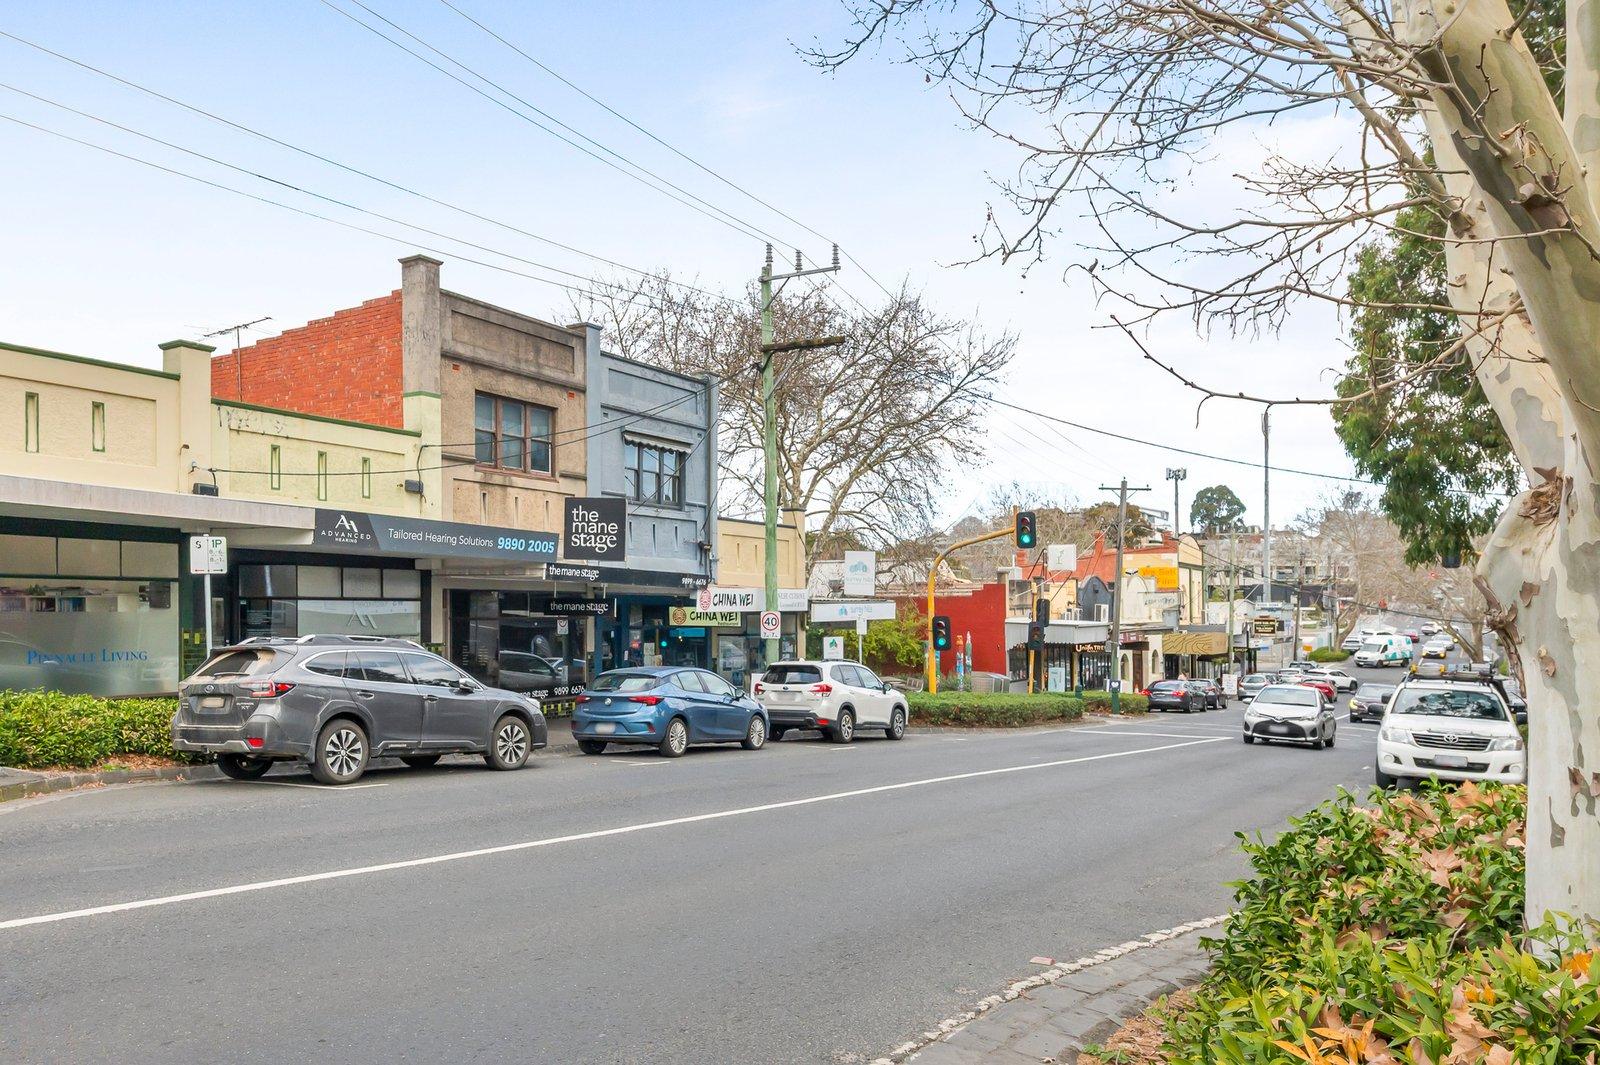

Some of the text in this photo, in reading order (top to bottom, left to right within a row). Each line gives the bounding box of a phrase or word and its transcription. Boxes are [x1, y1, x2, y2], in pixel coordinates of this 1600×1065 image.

[572, 505, 599, 522] the
[572, 521, 619, 534] mane
[321, 530, 371, 540] ADVANCED
[388, 528, 555, 554] Tailored Hearing Solutions 9890 2005
[211, 539, 222, 548] 1P
[571, 533, 617, 553] stage
[549, 564, 599, 581] the mane stage
[712, 593, 754, 607] CHINA WEI
[550, 601, 609, 614] the mane stage
[689, 611, 738, 622] CHINA WEI
[764, 617, 778, 626] 40
[101, 648, 148, 662] LIVING
